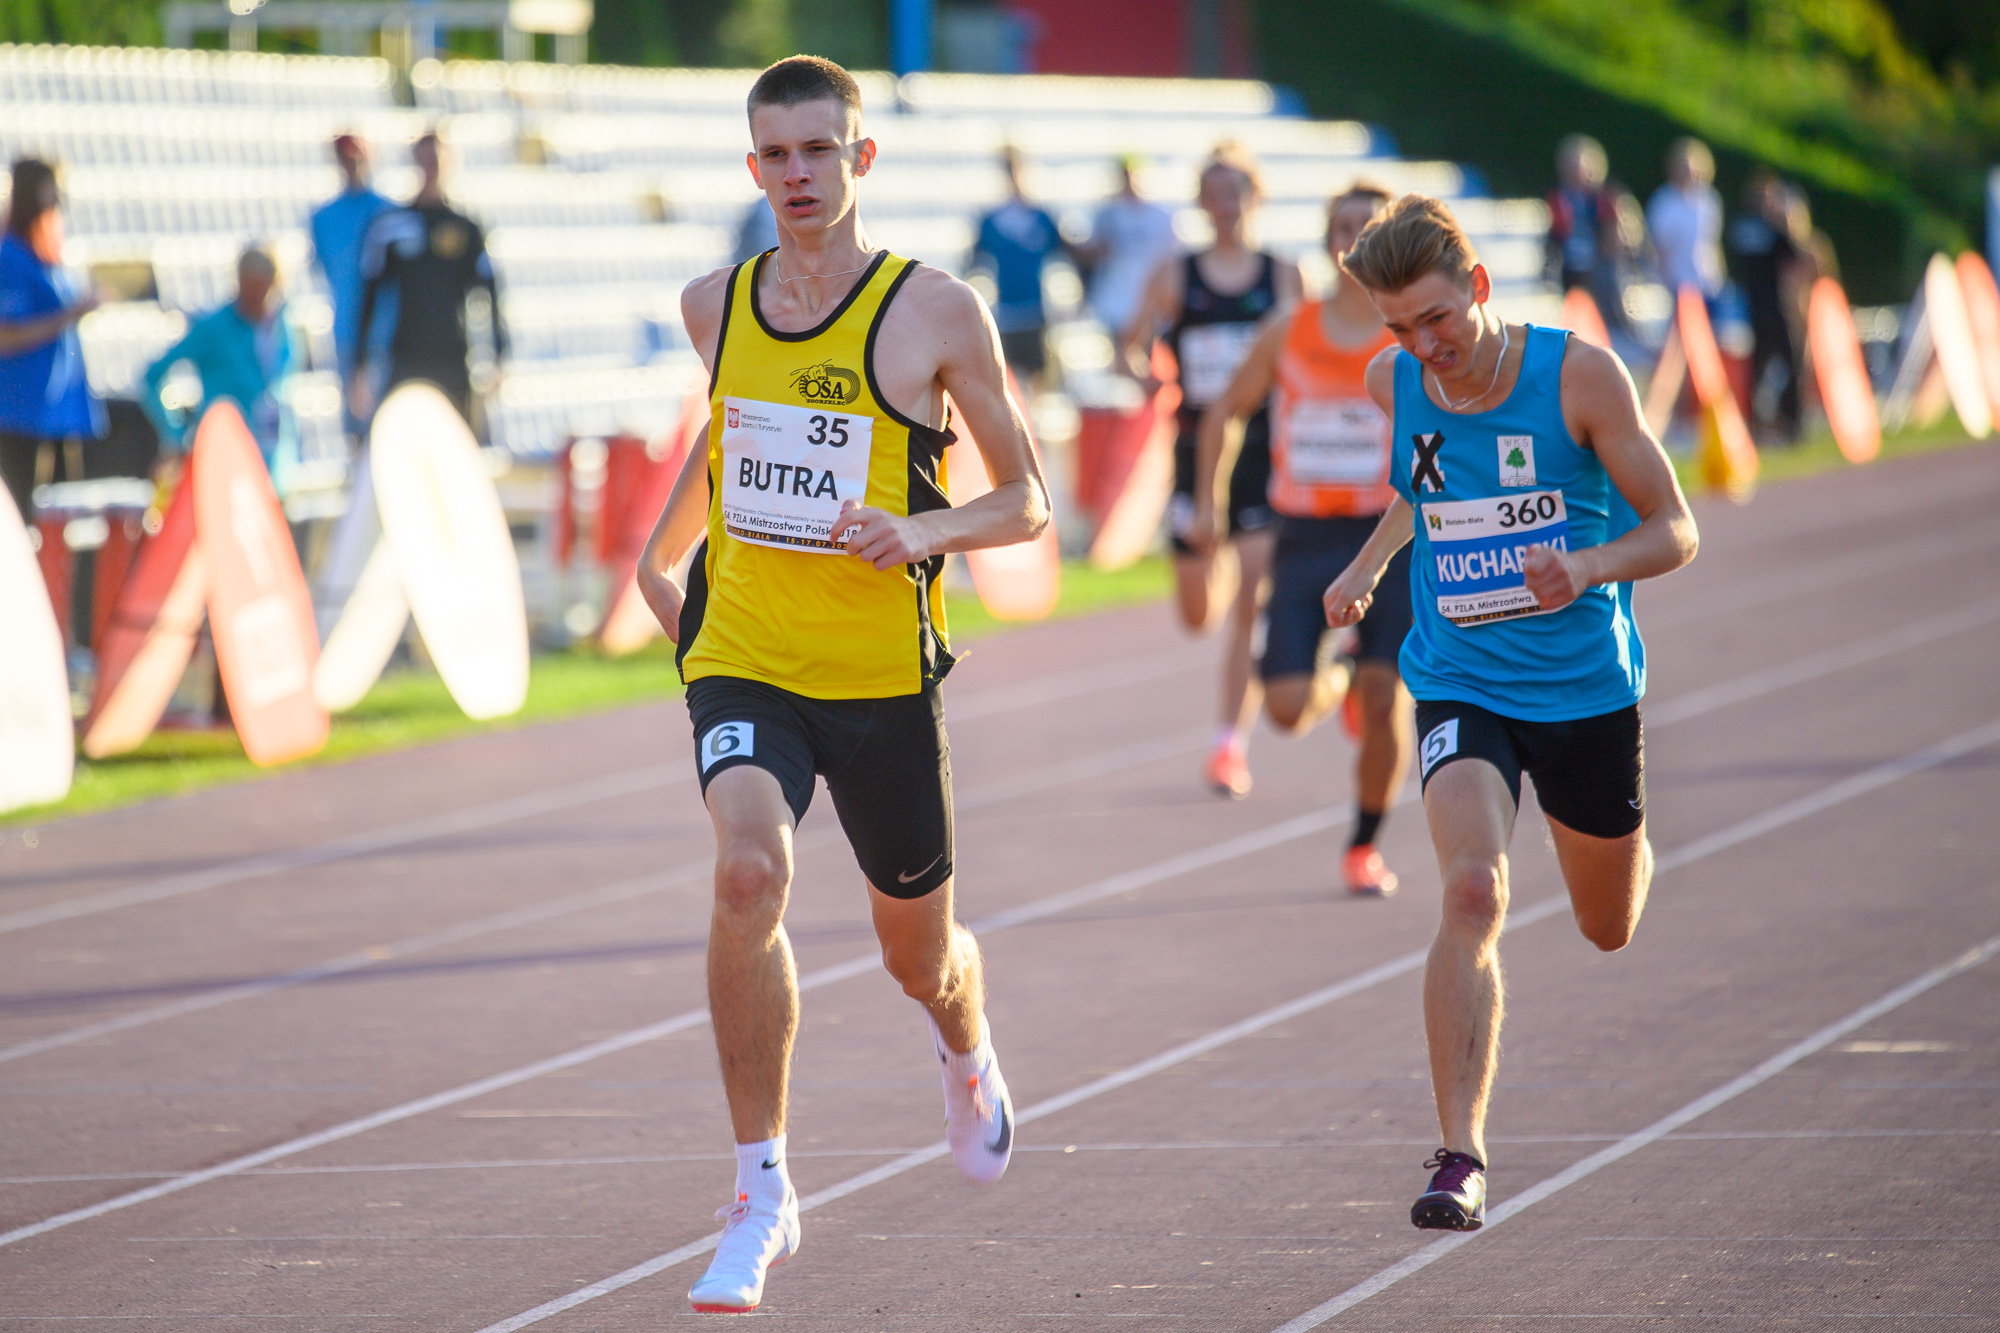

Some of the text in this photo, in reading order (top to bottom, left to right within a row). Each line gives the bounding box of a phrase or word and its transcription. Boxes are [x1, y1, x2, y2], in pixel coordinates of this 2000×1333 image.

[805, 379, 845, 399] OSA
[806, 415, 849, 448] 35
[1503, 438, 1529, 448] UKS
[738, 457, 839, 501] BUTRA
[732, 512, 748, 525] PZLA
[749, 516, 802, 533] Mistrzostwa
[805, 524, 832, 536] Polsk
[1496, 495, 1557, 529] 360
[1441, 605, 1453, 614] 54.
[1454, 603, 1475, 614] PZLA
[1478, 595, 1532, 610] Mistrzostwa
[710, 725, 740, 757] 6
[1426, 725, 1447, 764] 5
